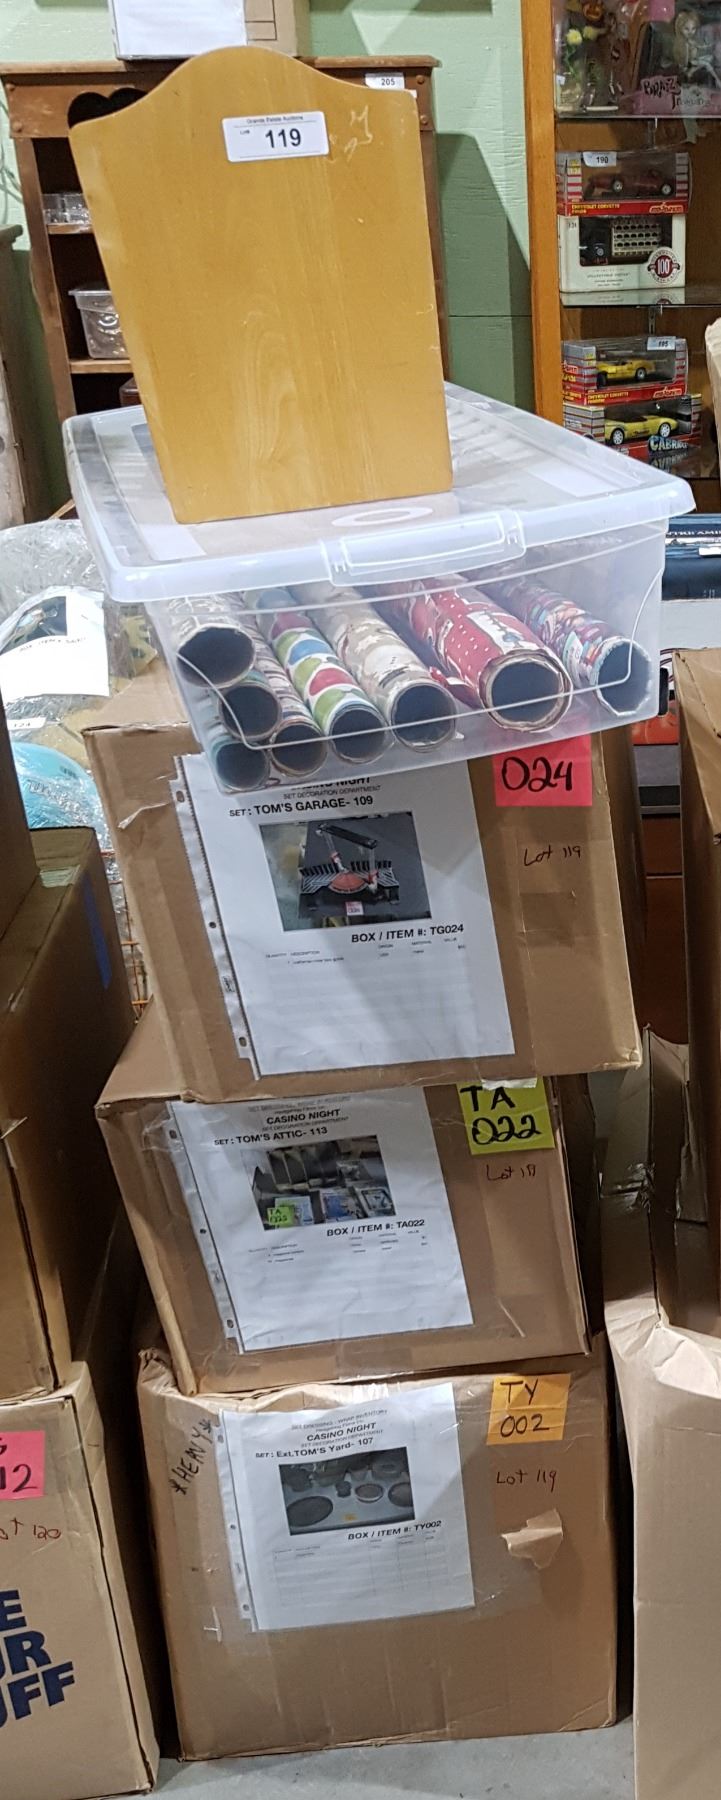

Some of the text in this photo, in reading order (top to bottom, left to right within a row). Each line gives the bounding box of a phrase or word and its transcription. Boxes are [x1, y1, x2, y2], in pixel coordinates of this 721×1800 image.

[381, 78, 396, 86] 205
[265, 128, 301, 149] 119
[596, 156, 609, 164] 190
[657, 259, 670, 274] 100
[501, 756, 573, 792] 024
[297, 789, 338, 799] DECORATION
[339, 785, 381, 796] DEPARTMENT
[254, 802, 293, 816] TOM'S
[295, 797, 350, 811] GARAGE-
[353, 795, 374, 806] 109
[524, 844, 581, 867] Lot 119
[351, 932, 376, 943] BOX
[386, 928, 414, 940] ITEM
[430, 923, 464, 936] TG024
[460, 1085, 516, 1112] TA
[266, 1108, 341, 1125] CASINO NIGHT
[236, 1132, 270, 1144] TOM'S
[273, 1128, 307, 1140] ATTIC-
[310, 1126, 328, 1136] 113
[471, 1114, 542, 1146] 022
[486, 1164, 514, 1181] Lot
[326, 1226, 349, 1237] BOX
[357, 1222, 382, 1233] ITEM
[397, 1219, 425, 1229] TA022
[500, 1378, 539, 1406] TY
[306, 1422, 377, 1442] CASINO NIGHT
[500, 1412, 550, 1438] 002
[358, 1437, 374, 1446] 107
[496, 1469, 557, 1493] Lot 119
[32, 1524, 62, 1541] 120
[347, 1531, 369, 1540] BOX
[377, 1527, 401, 1537] ITEM
[414, 1520, 442, 1532] TY002
